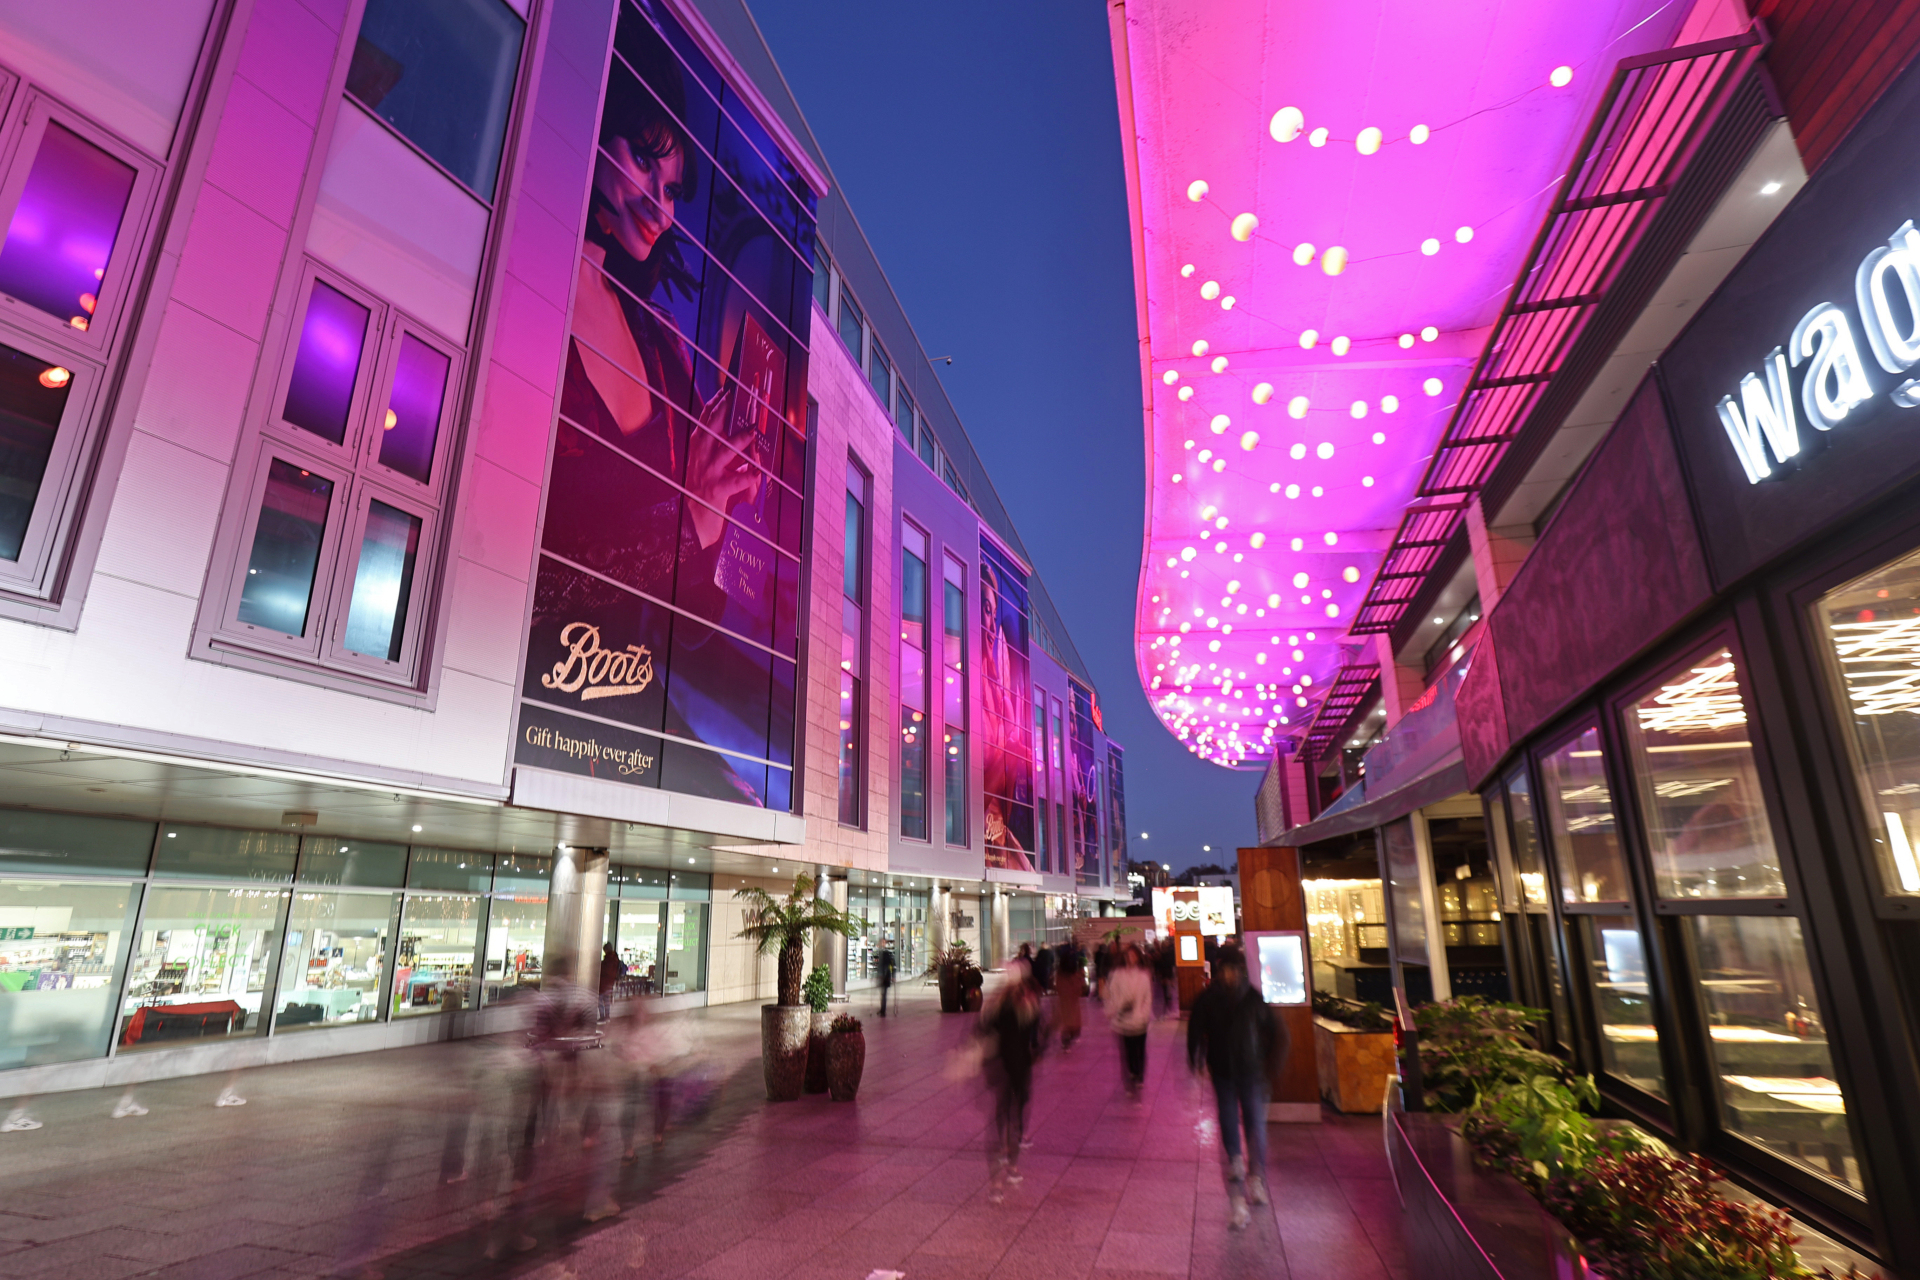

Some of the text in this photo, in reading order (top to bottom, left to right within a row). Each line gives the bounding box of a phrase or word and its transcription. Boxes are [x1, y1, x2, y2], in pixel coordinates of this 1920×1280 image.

[733, 529, 741, 539] To
[727, 539, 765, 574] Snowy
[738, 576, 756, 600] Puss
[542, 621, 653, 701] Boots
[526, 725, 653, 775] Gift happily ever after
[194, 923, 242, 938] CLICK
[173, 954, 249, 970] COLLECT
